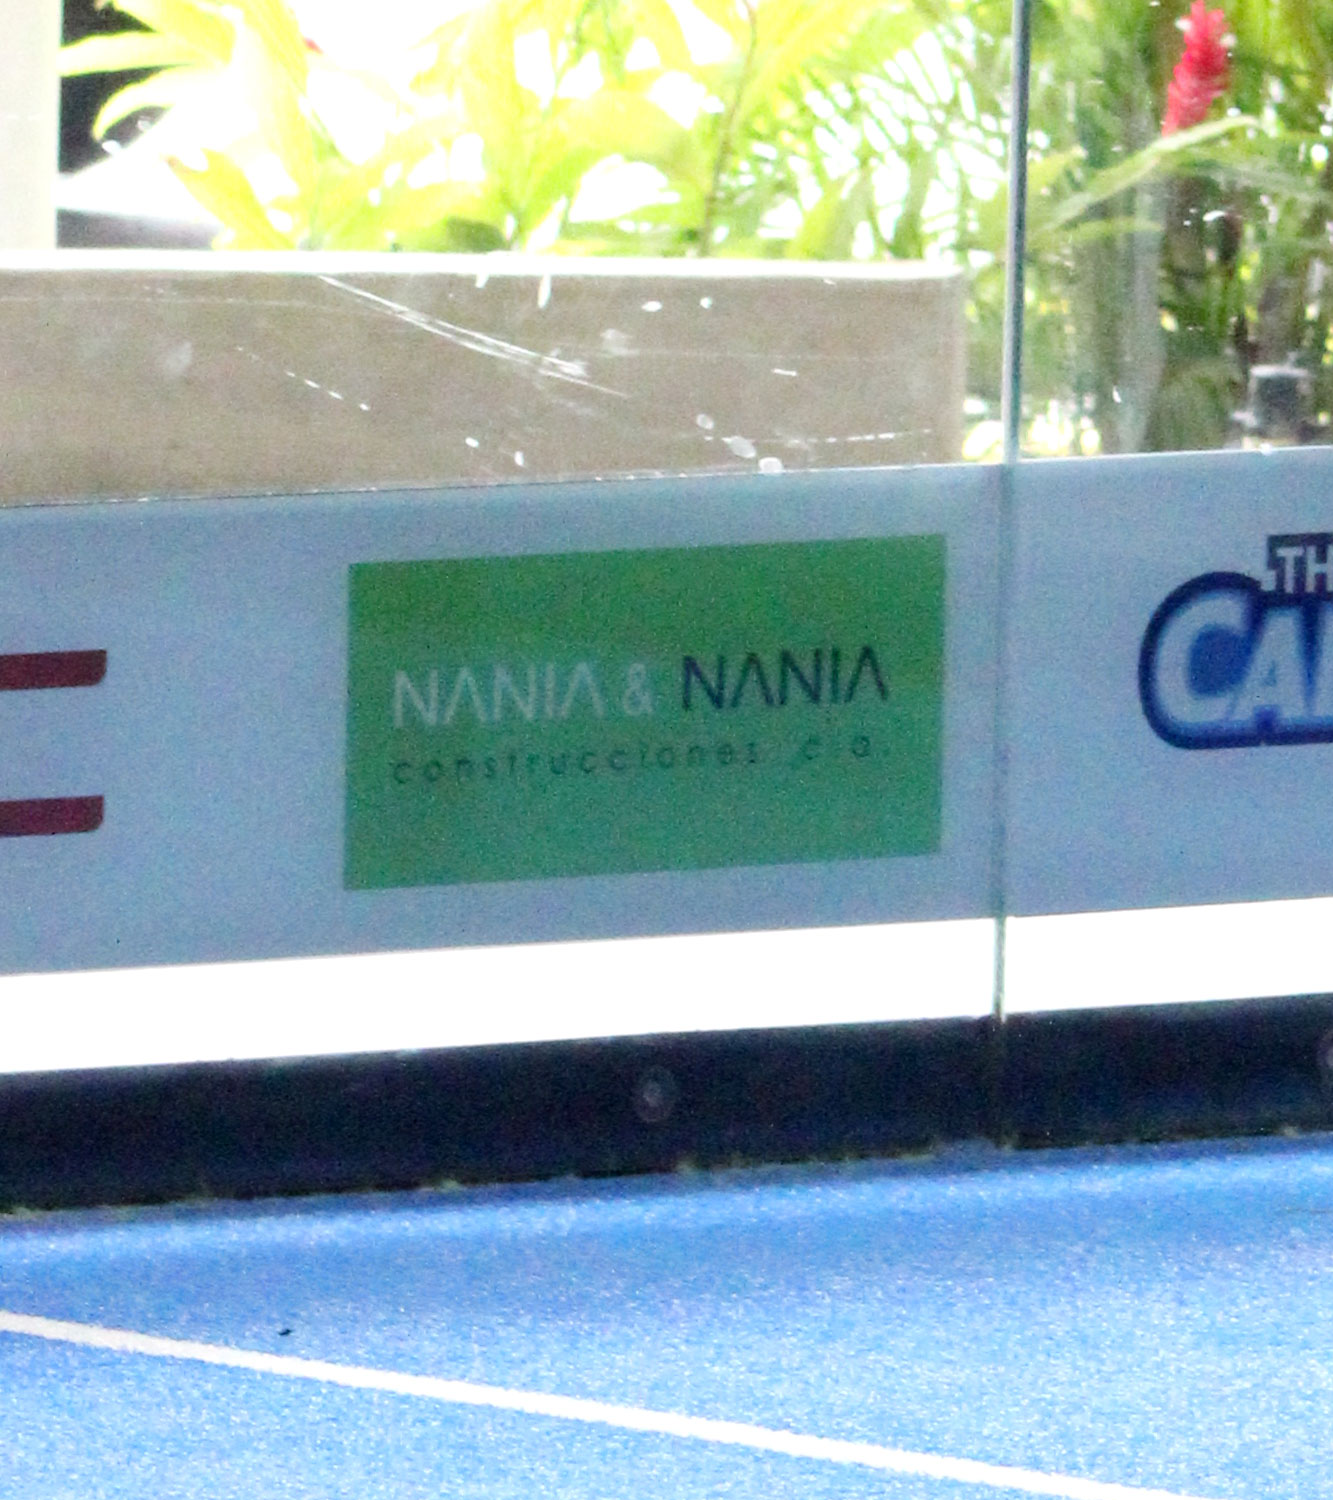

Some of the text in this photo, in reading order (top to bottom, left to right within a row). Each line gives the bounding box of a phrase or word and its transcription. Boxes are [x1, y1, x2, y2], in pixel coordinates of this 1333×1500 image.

[394, 646, 889, 727] NANIA & NANIA
